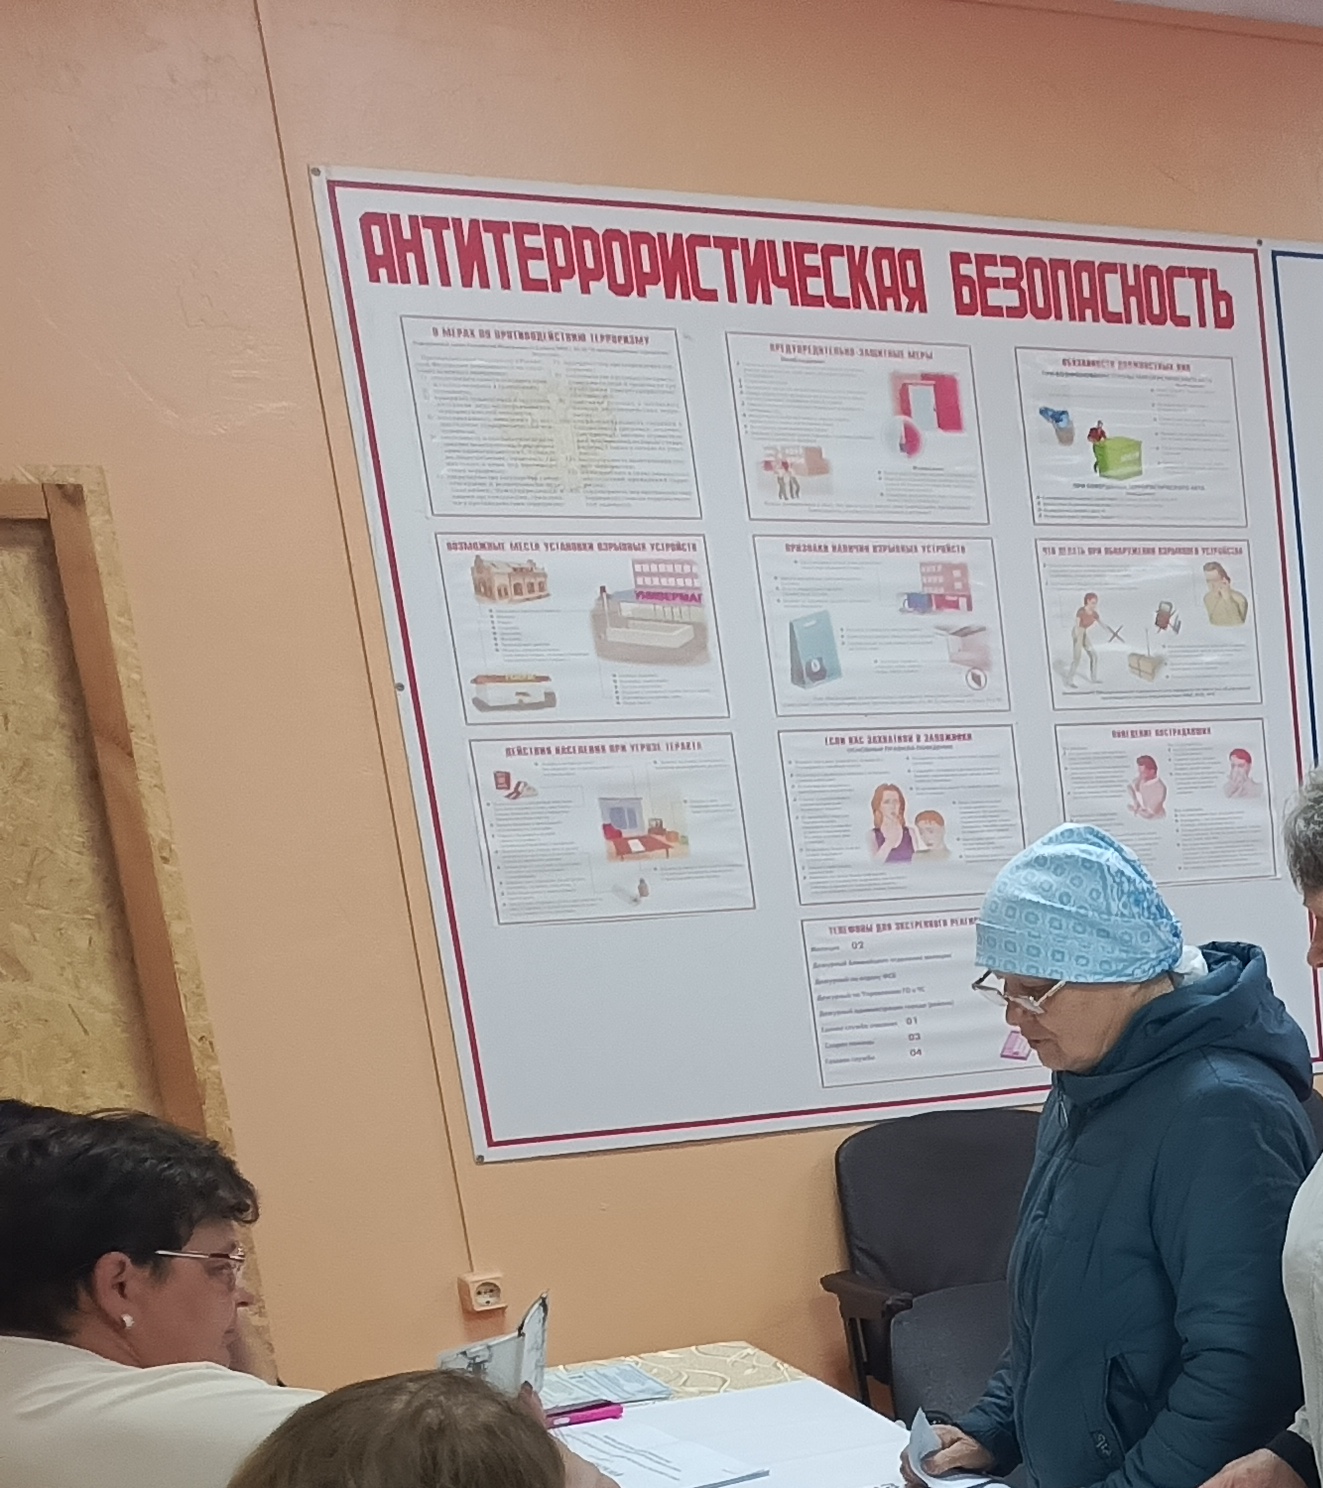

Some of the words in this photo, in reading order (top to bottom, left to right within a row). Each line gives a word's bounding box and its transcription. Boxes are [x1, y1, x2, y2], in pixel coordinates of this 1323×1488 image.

[359, 212, 928, 313] АНТИТЕРРОРИСТИЧЕСКАЯ
[951, 250, 1235, 330] БЕЗОПАСНОСТЬ
[851, 940, 865, 951] 02
[905, 1016, 919, 1026] 01
[908, 1032, 922, 1042] 03
[909, 1048, 923, 1058] 04
